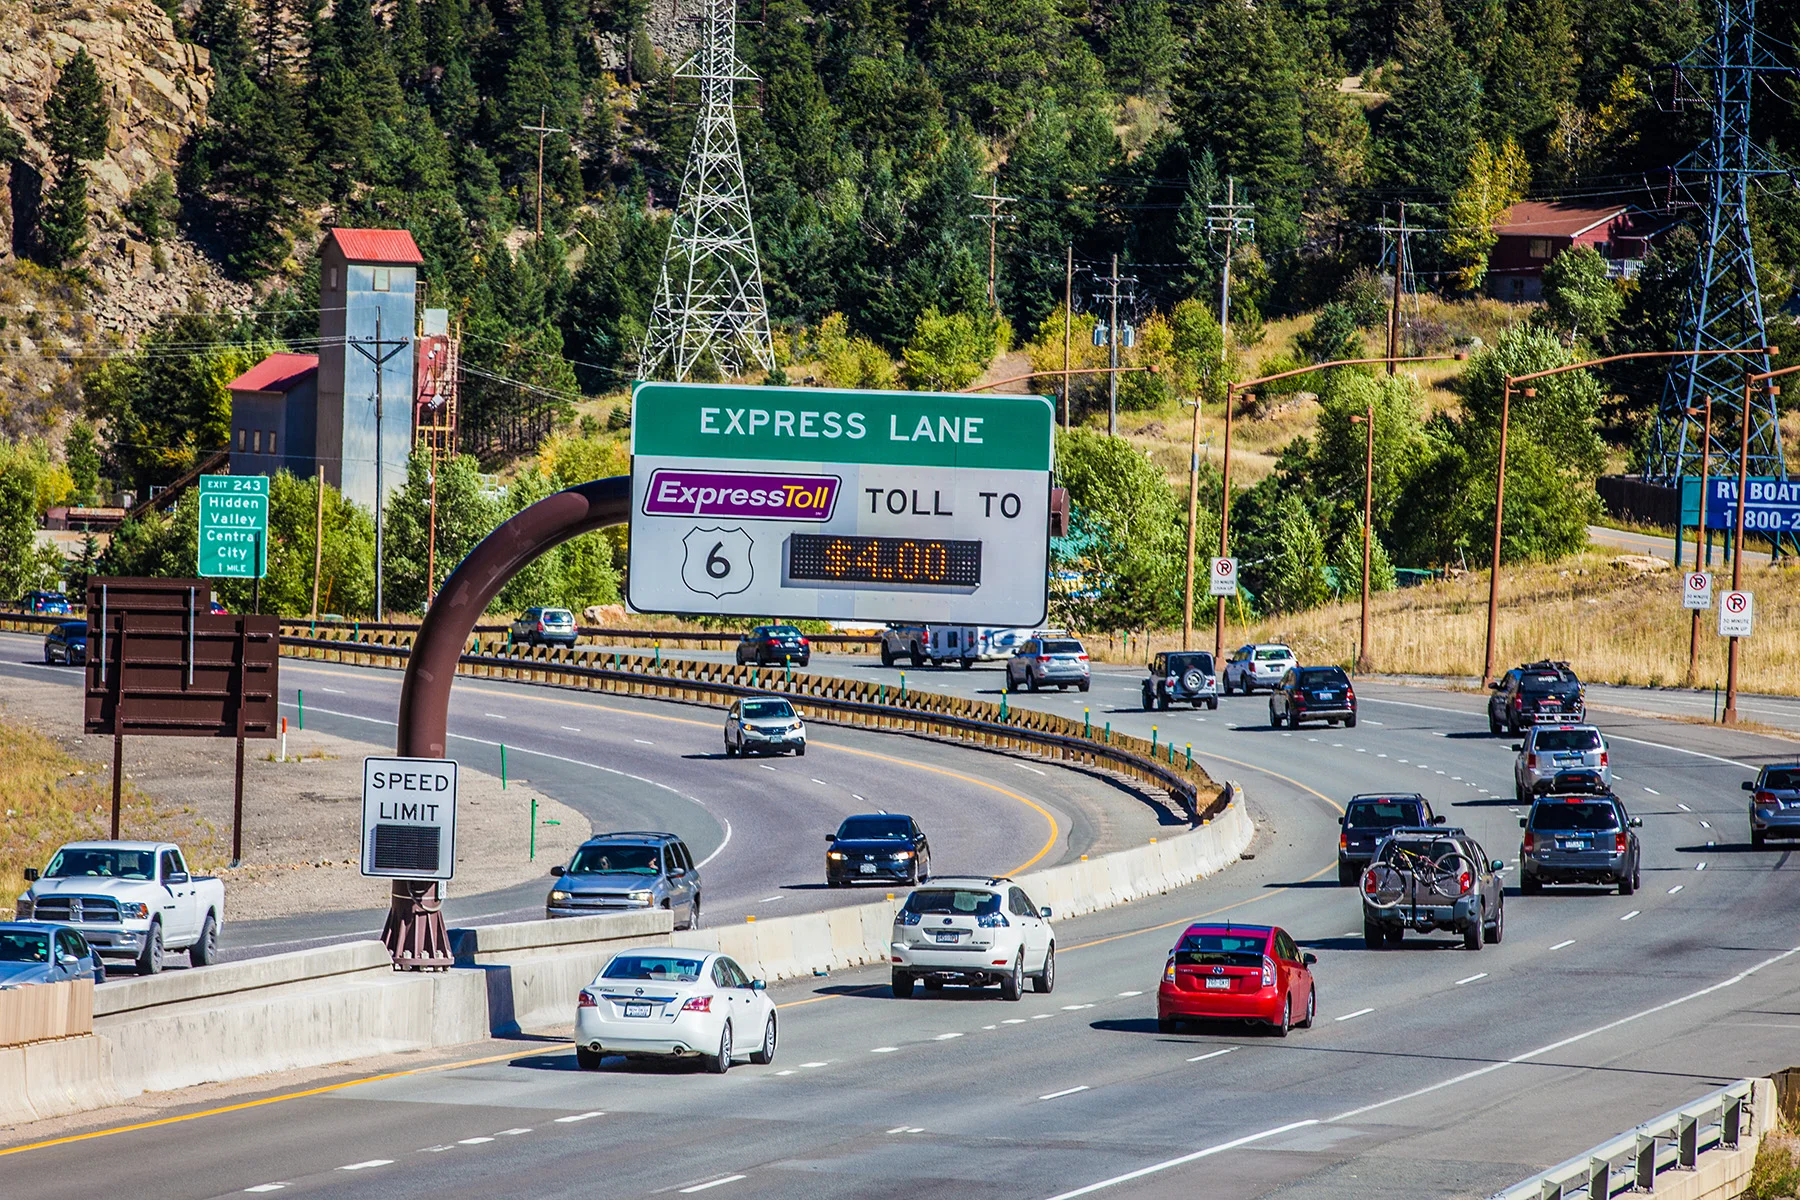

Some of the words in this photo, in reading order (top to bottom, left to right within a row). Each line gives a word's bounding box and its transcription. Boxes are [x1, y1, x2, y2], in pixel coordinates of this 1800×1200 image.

[701, 407, 867, 439] EXPRESS
[890, 414, 984, 444] LANE
[207, 481, 228, 489] EXIT
[233, 480, 261, 491] 243
[209, 496, 259, 509] Hidden
[657, 480, 829, 515] ExpressToll
[865, 487, 953, 516] TOLL
[979, 492, 1021, 519] TO
[210, 512, 256, 527] Valley
[1723, 509, 1800, 530] 1800-2
[217, 546, 247, 560] City
[705, 541, 731, 579] 6
[825, 539, 946, 581] $4.00
[218, 562, 222, 573] 1
[226, 564, 247, 573] MILE
[372, 772, 449, 792] SPEED
[380, 802, 439, 821] LIMIT
